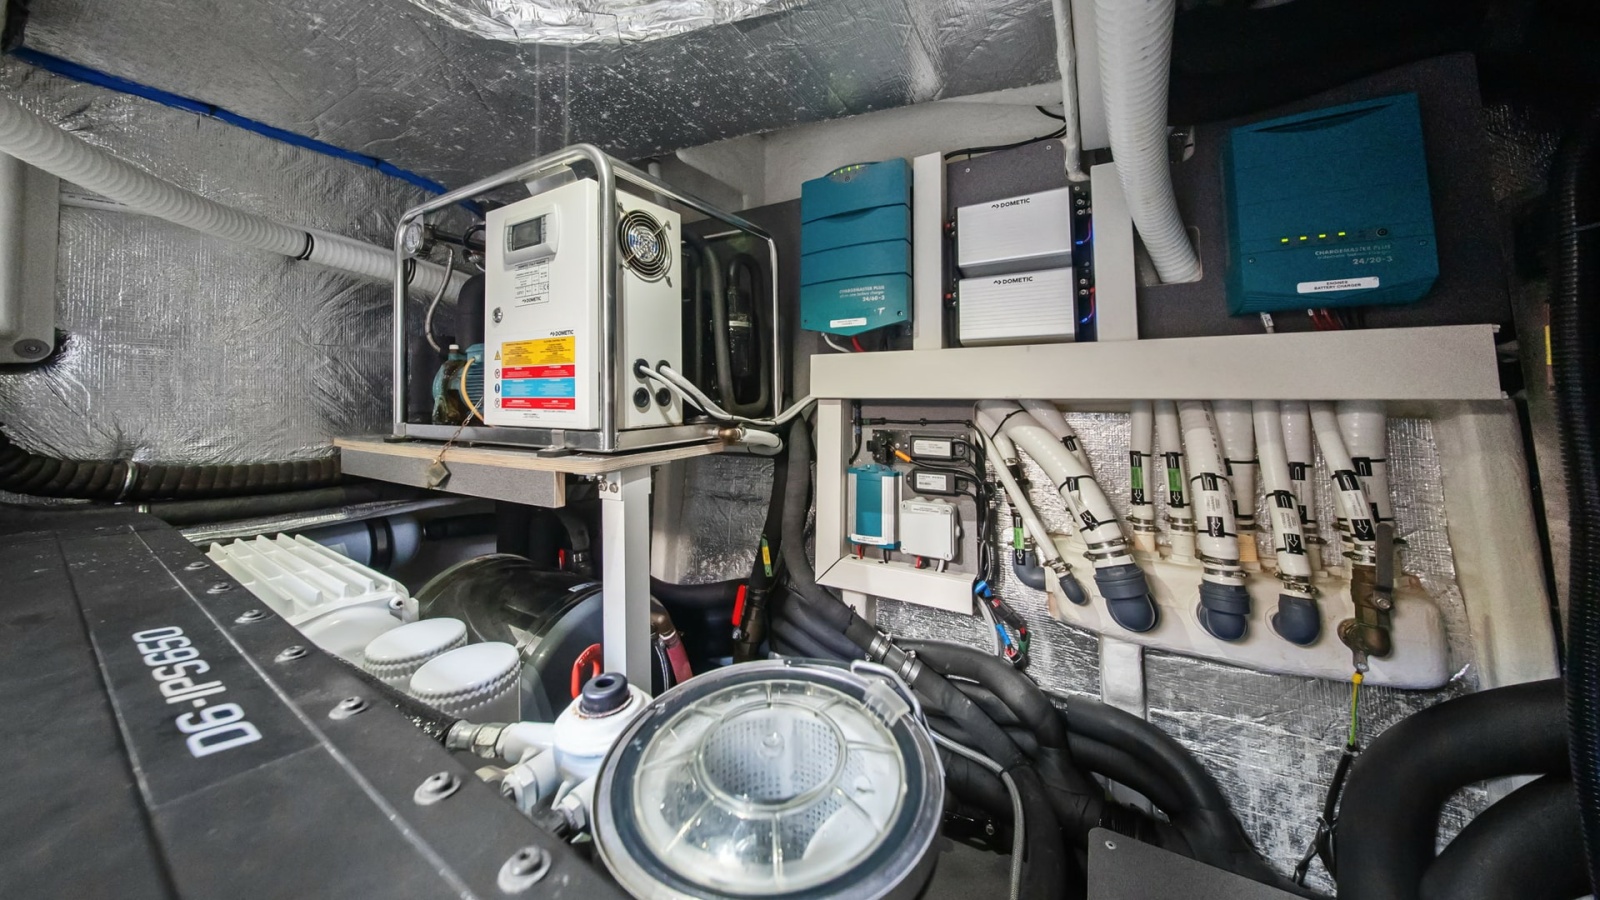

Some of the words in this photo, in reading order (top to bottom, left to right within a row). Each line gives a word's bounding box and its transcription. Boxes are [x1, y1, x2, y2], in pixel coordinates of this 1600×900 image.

[1000, 197, 1031, 208] DOMETIC
[1352, 256, 1393, 265] 24/20-3
[1002, 276, 1033, 285] DOMETIC
[555, 329, 574, 337] DOMETIC
[132, 626, 262, 758] D6-IPS650
